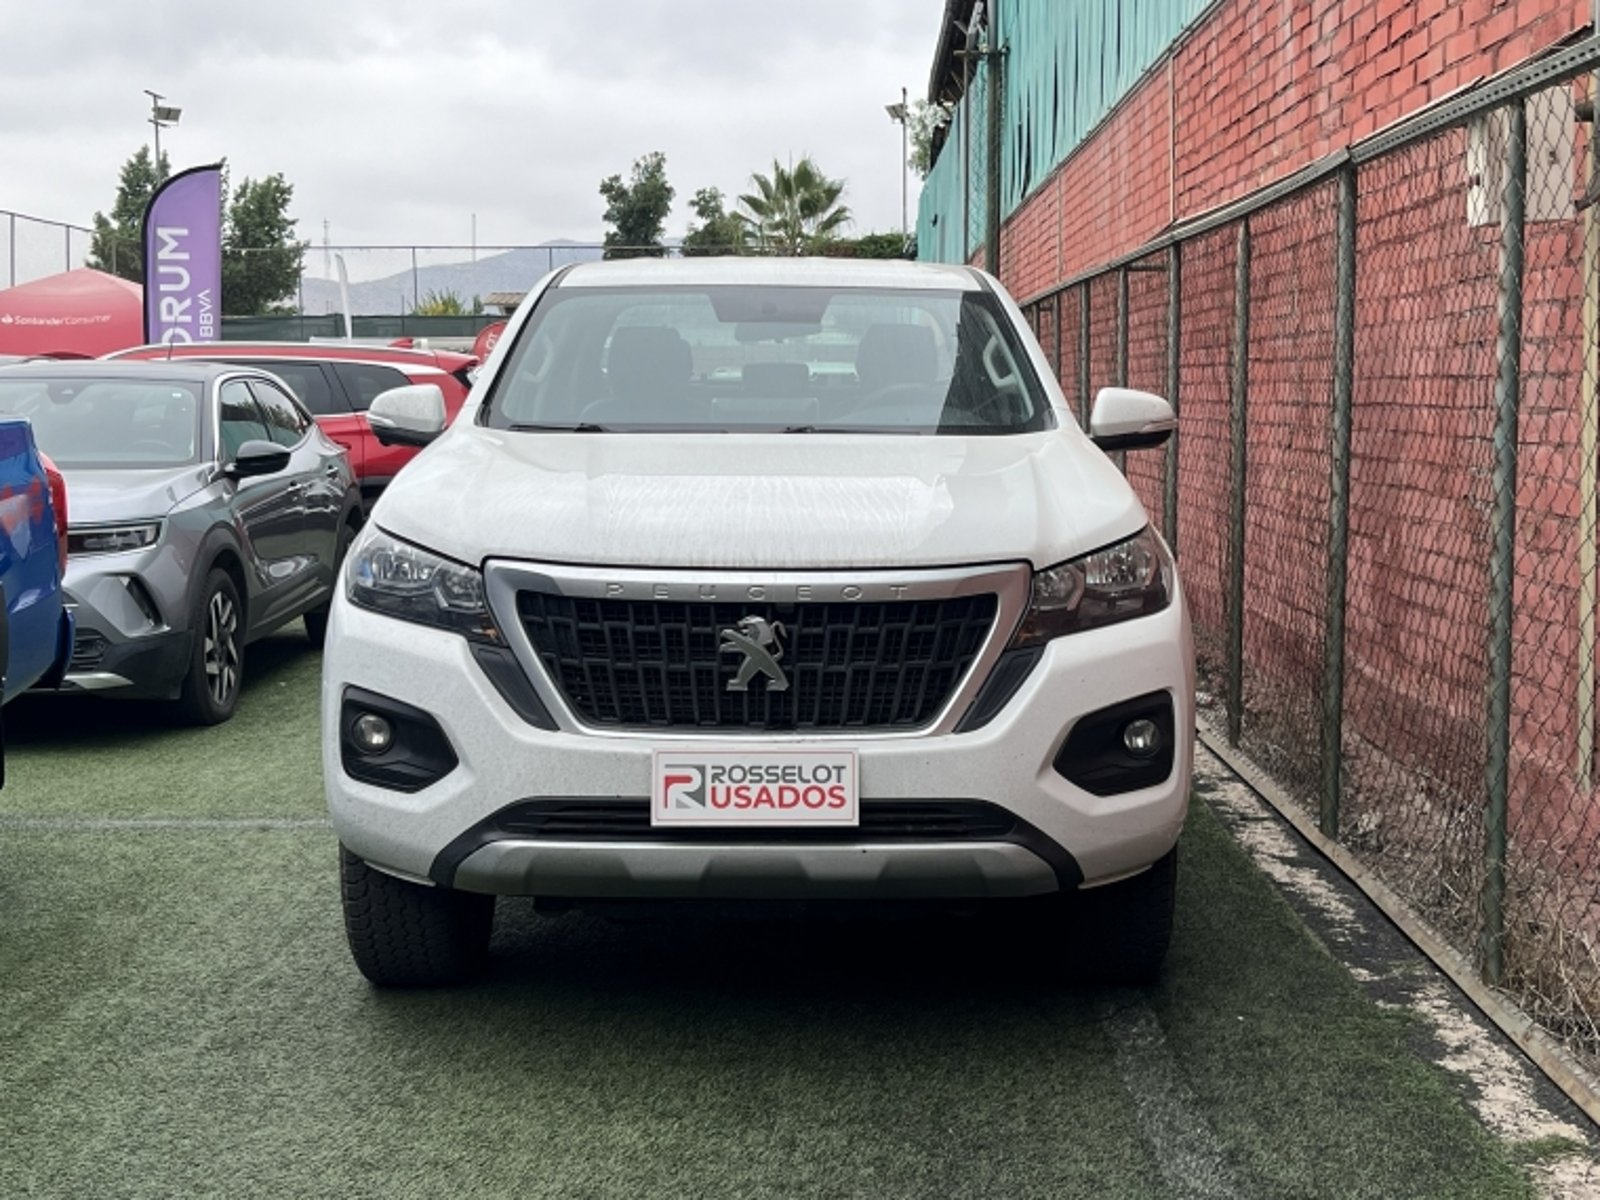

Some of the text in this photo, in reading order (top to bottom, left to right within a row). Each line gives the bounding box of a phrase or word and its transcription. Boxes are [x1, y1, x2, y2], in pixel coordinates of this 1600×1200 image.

[198, 288, 213, 337] BBVA
[605, 583, 908, 601] PEUGEOT
[711, 765, 846, 783] ROSSELOT
[711, 785, 846, 809] USADOS
